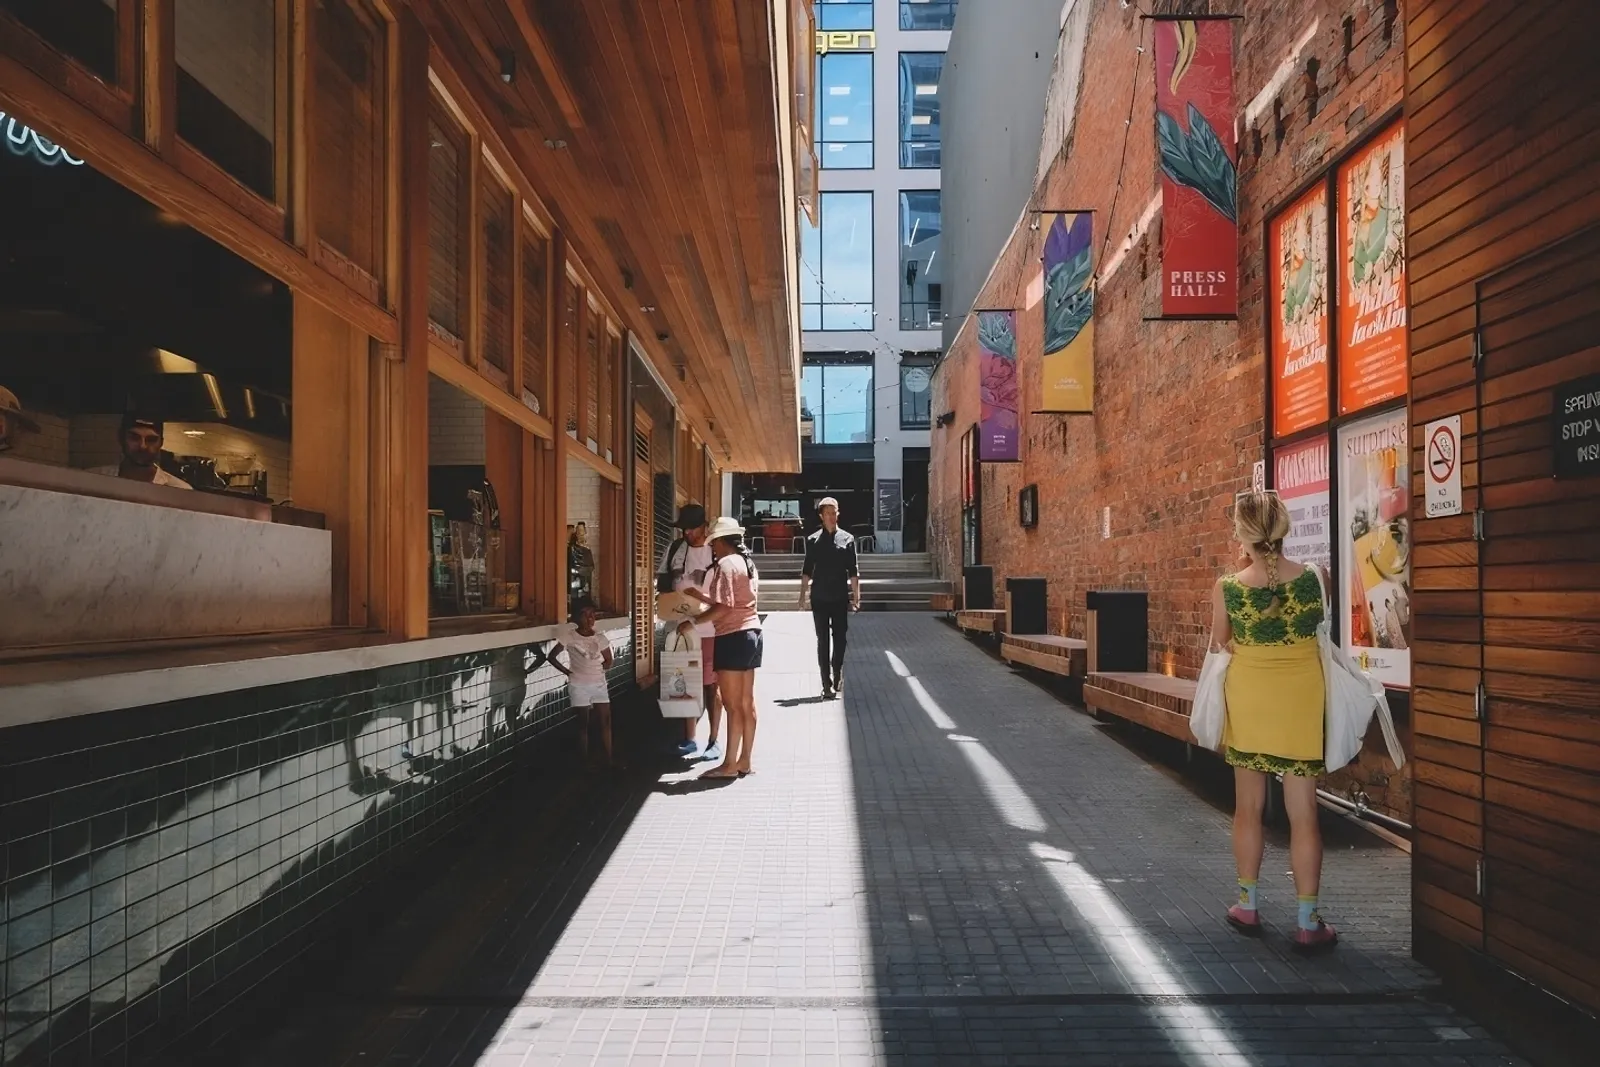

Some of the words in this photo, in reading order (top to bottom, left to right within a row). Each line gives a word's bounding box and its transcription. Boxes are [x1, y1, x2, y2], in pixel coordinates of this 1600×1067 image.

[1171, 270, 1226, 284] PRESS
[1171, 285, 1218, 297] HALL
[1562, 419, 1593, 440] STOP
